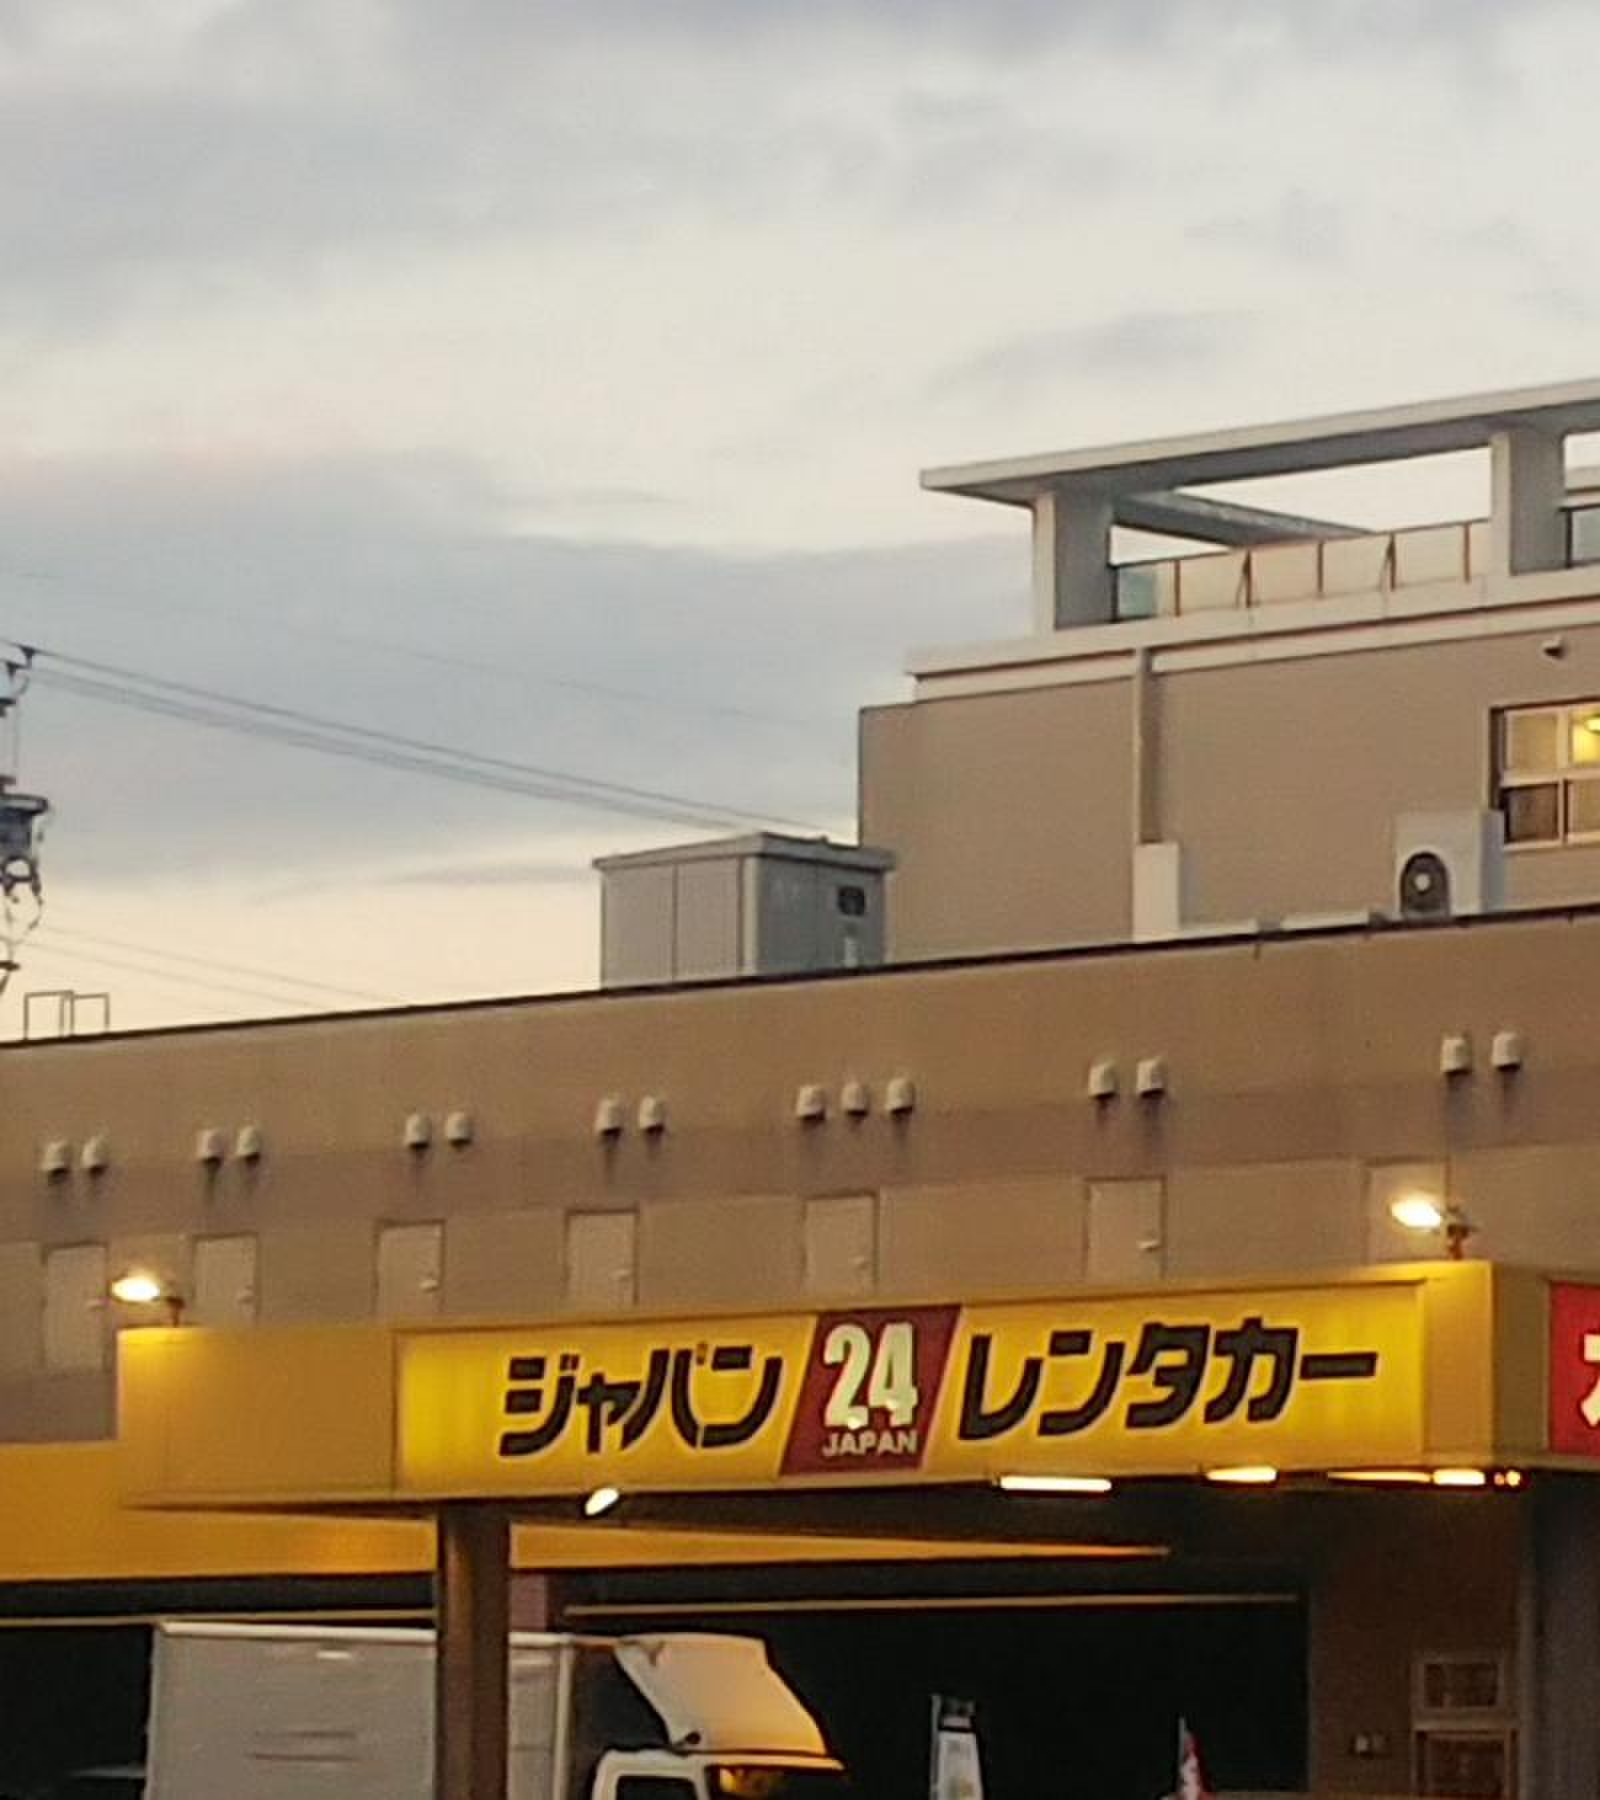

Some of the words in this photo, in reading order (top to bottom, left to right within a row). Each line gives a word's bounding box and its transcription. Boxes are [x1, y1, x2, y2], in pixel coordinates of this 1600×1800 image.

[499, 1343, 783, 1457] ジャパン
[823, 1322, 918, 1430] 24
[958, 1317, 1378, 1441] レンタカー
[822, 1430, 918, 1457] JAPAN
